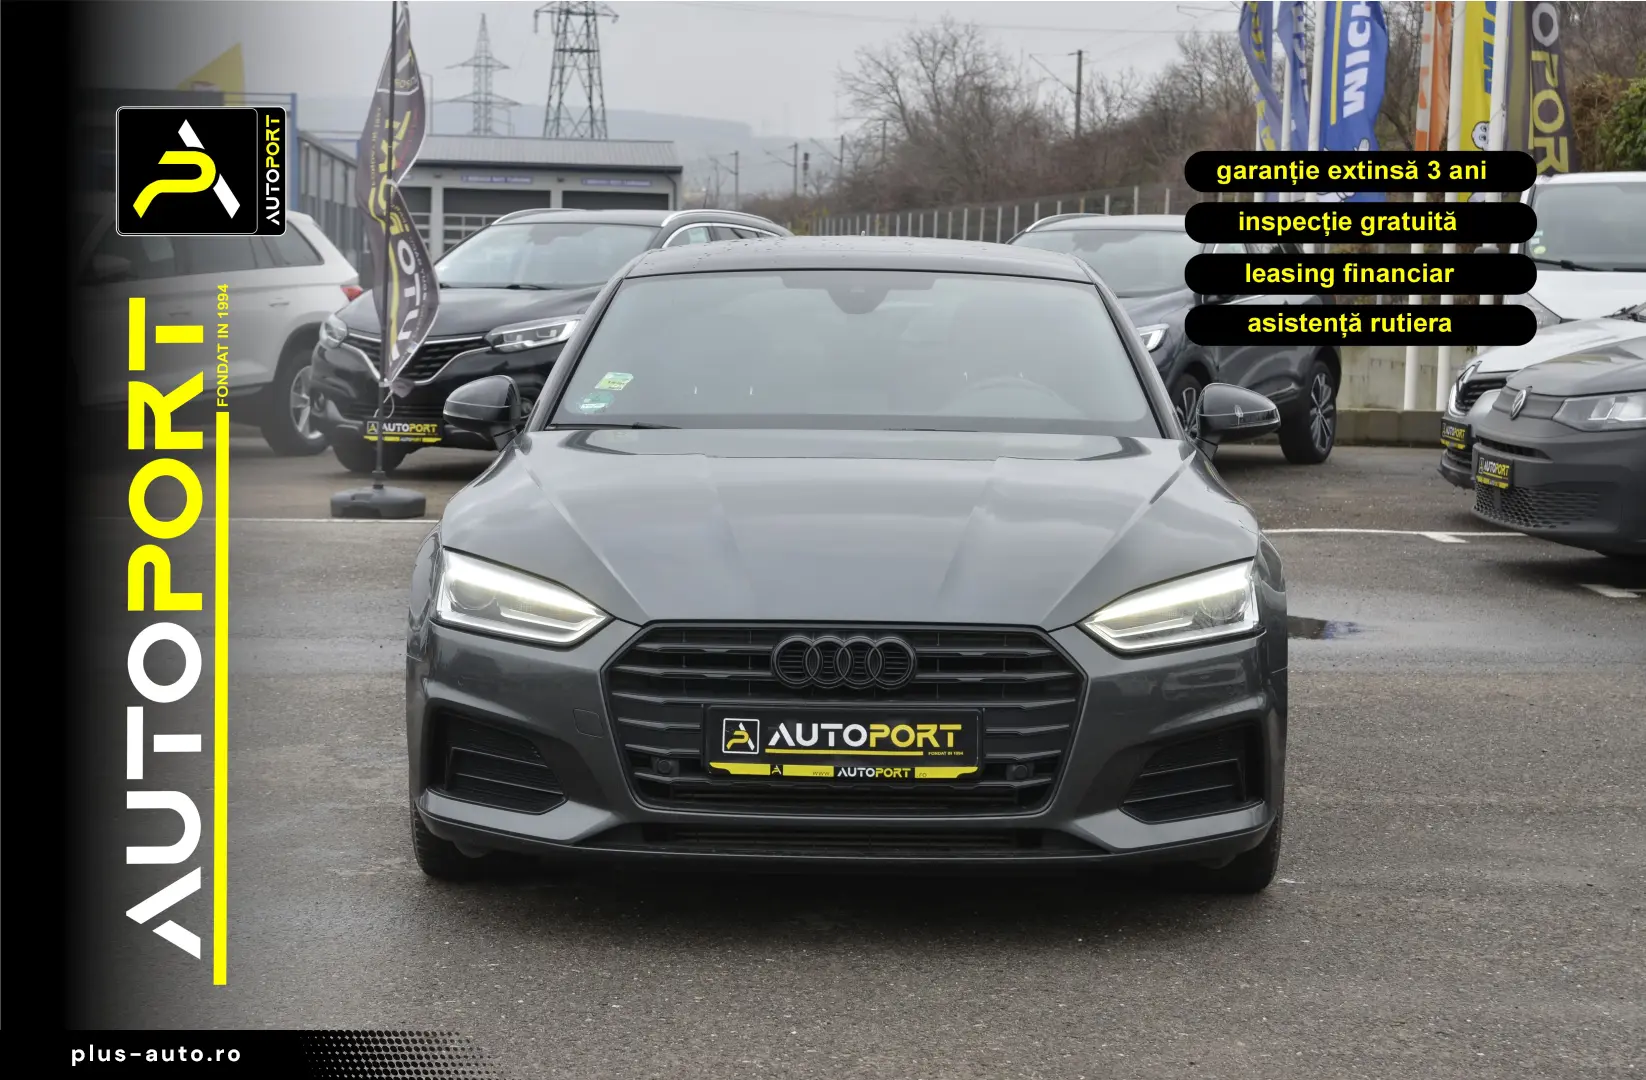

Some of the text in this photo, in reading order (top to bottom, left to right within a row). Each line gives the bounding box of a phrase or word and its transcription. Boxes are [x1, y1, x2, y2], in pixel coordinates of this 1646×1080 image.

[382, 422, 438, 433] AUTOPORT
[768, 722, 962, 748] AUTOPORT
[837, 767, 911, 779] AUTOPORT
